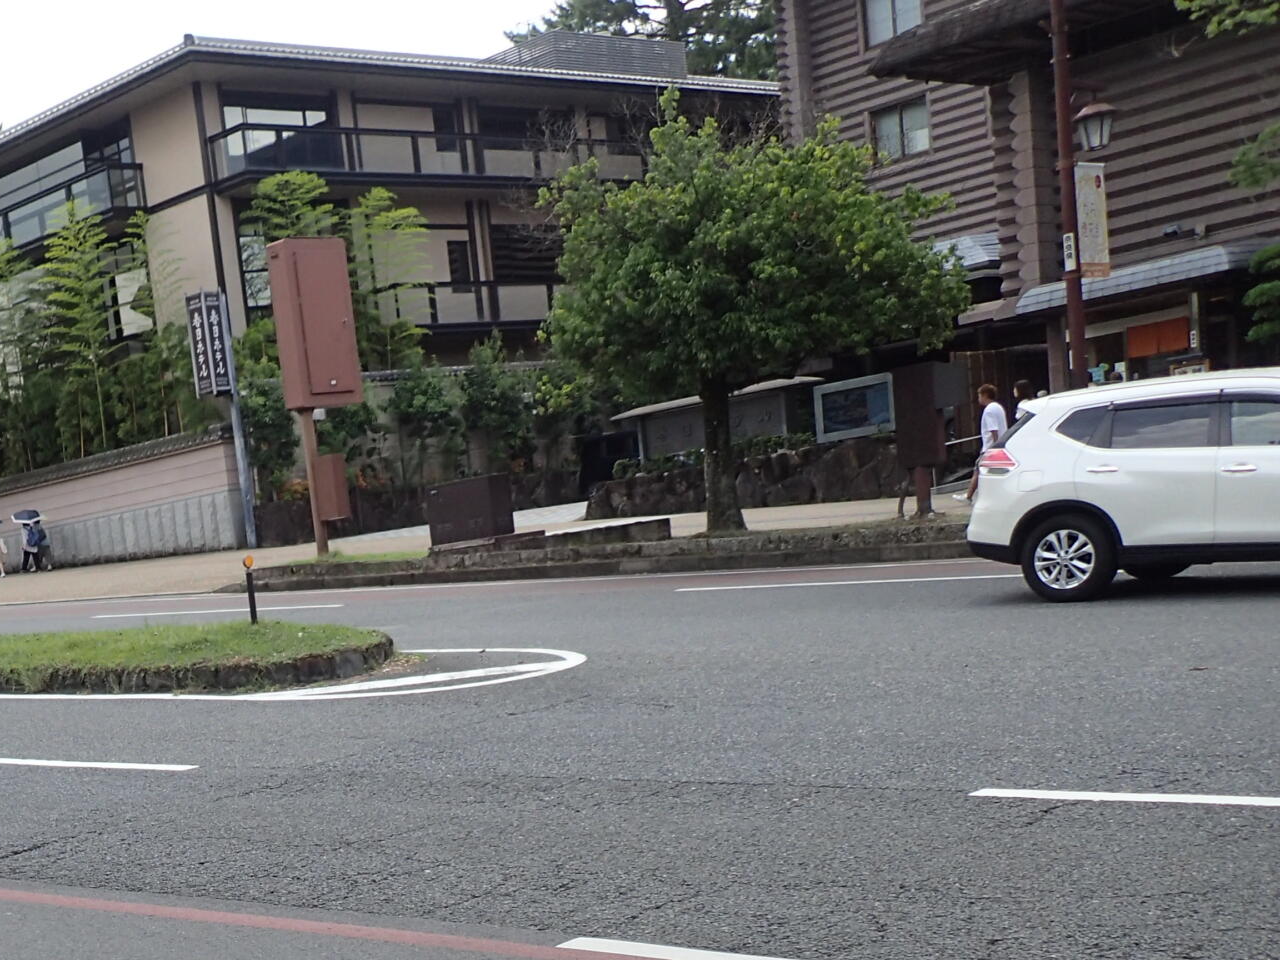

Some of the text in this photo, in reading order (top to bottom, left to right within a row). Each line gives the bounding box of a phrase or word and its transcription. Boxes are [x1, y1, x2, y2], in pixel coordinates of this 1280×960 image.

[192, 312, 208, 377] 春日ホテル
[209, 309, 225, 374] 春日ホテル
